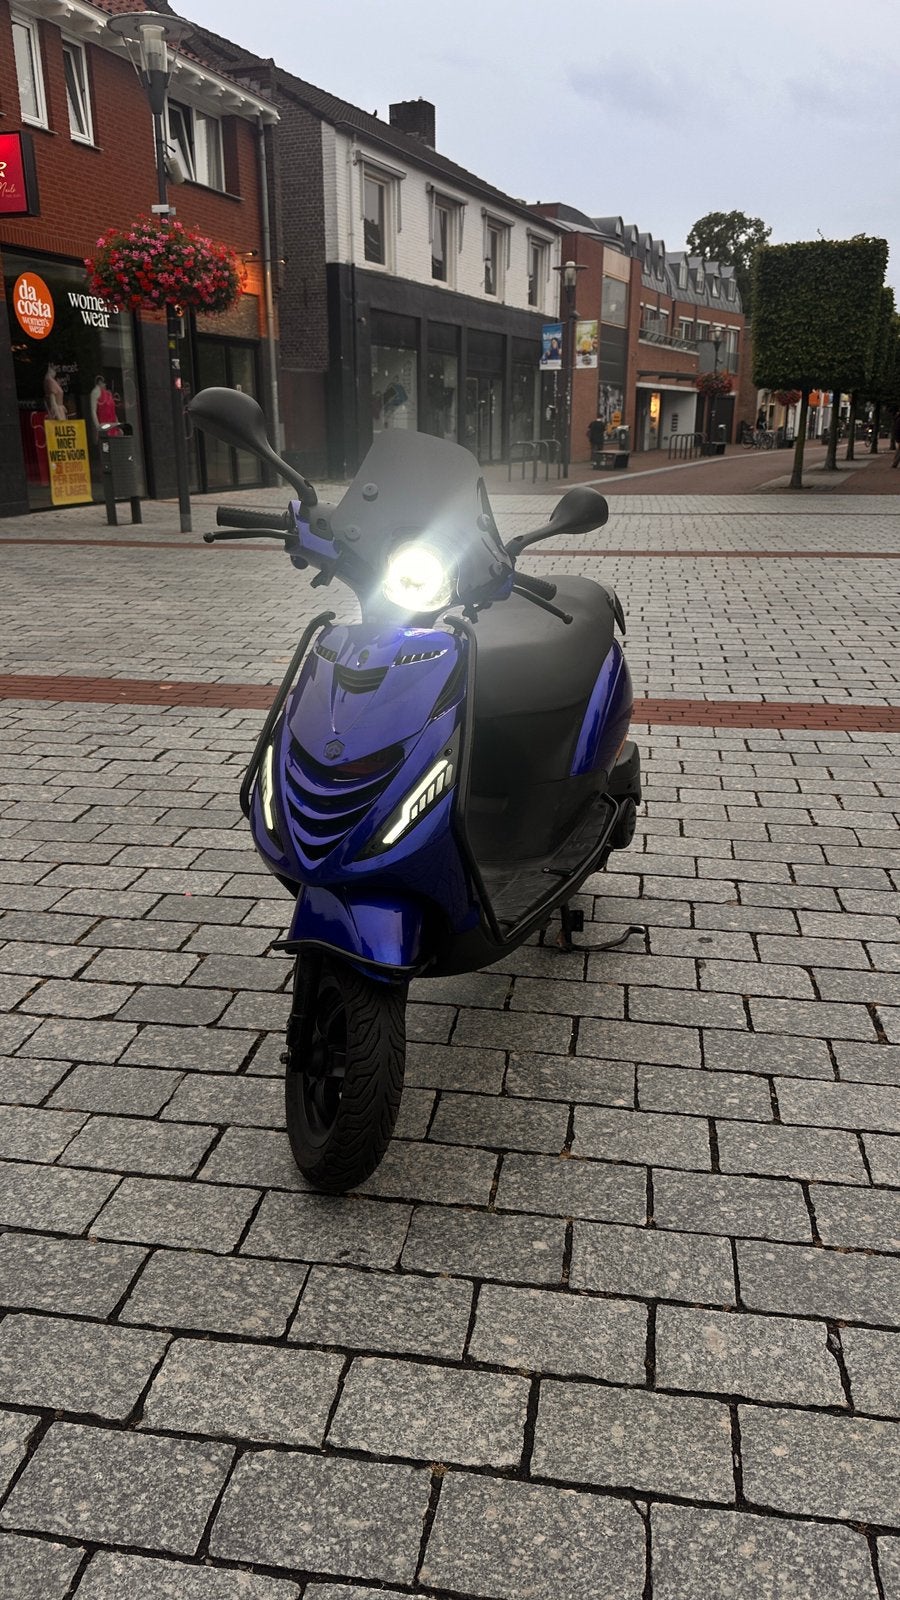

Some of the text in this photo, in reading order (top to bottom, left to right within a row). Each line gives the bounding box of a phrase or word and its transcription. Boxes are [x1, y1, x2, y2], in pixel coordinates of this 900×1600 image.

[19, 279, 36, 301] da
[17, 298, 51, 318] costa
[67, 292, 119, 314] womes
[21, 316, 49, 327] women's
[81, 310, 110, 328] wear
[29, 325, 45, 334] wear
[54, 425, 76, 437] ALLES
[56, 437, 76, 449] MOET
[49, 449, 85, 462] WEG VOOR
